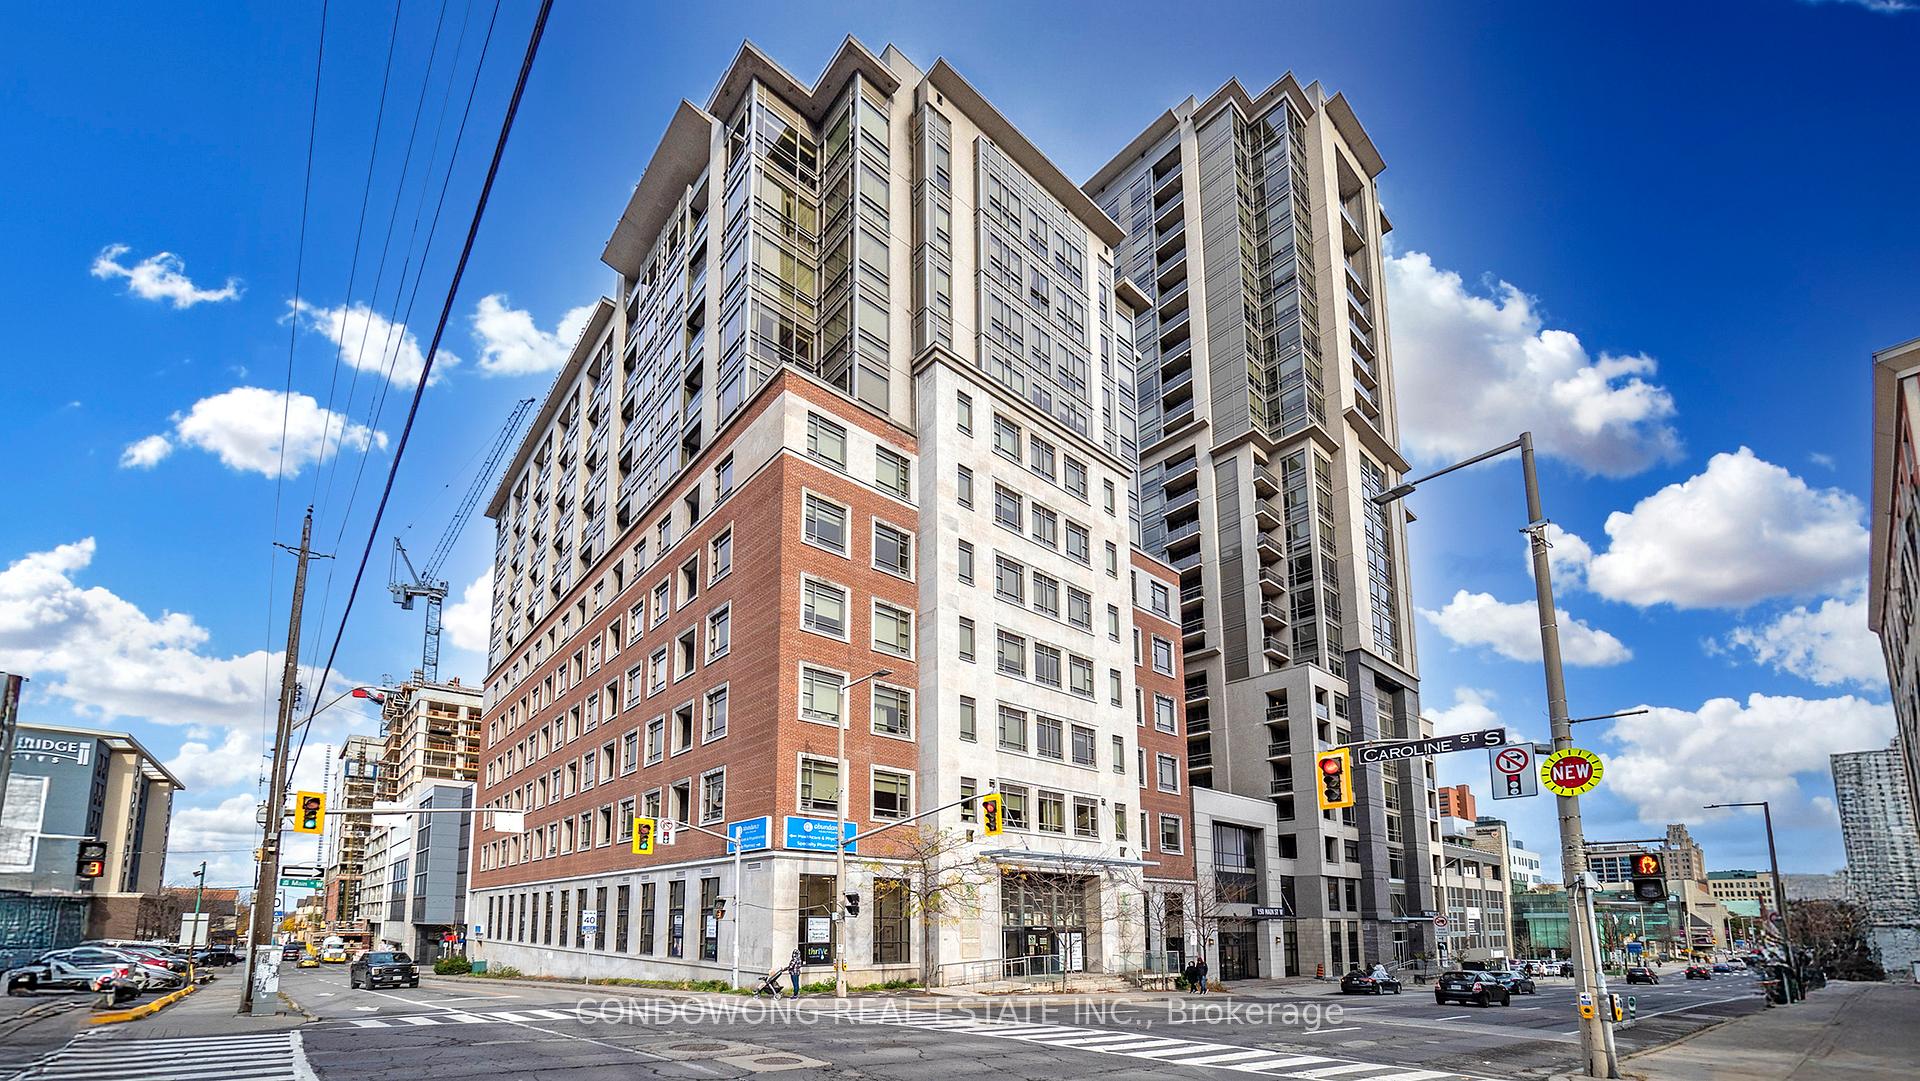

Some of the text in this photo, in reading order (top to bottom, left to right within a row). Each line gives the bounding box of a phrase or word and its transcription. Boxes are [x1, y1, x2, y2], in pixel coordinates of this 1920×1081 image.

[1363, 731, 1501, 762] CAROLINE ST S
[1552, 763, 1590, 780] NEW
[90, 861, 99, 874] 3
[583, 916, 596, 924] 40
